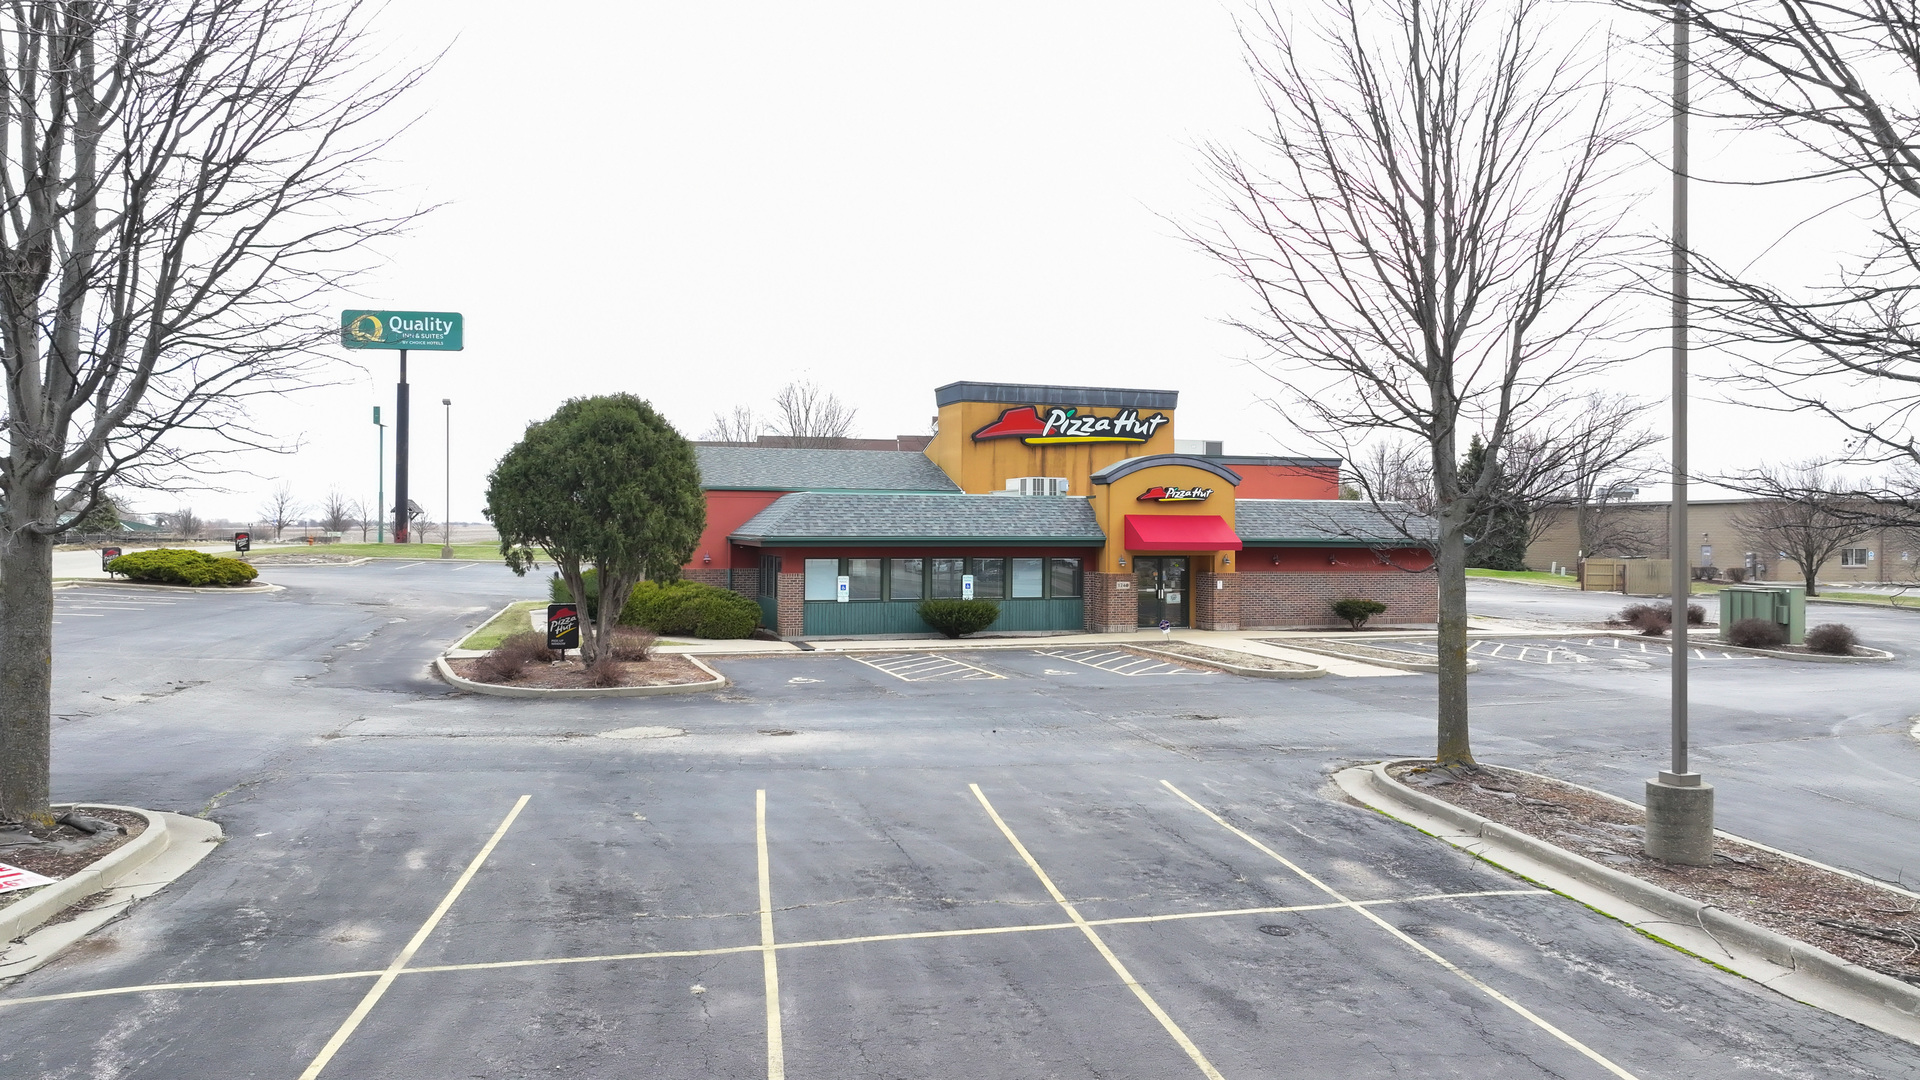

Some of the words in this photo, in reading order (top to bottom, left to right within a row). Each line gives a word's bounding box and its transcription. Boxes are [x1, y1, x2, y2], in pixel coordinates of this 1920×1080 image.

[389, 316, 453, 335] Quality
[1042, 408, 1110, 437] Pizza
[1113, 410, 1168, 435] Hut
[1165, 487, 1192, 499] Pizza
[1192, 487, 1214, 498] Hut
[551, 616, 576, 632] Pizza
[555, 622, 574, 634] Hut
